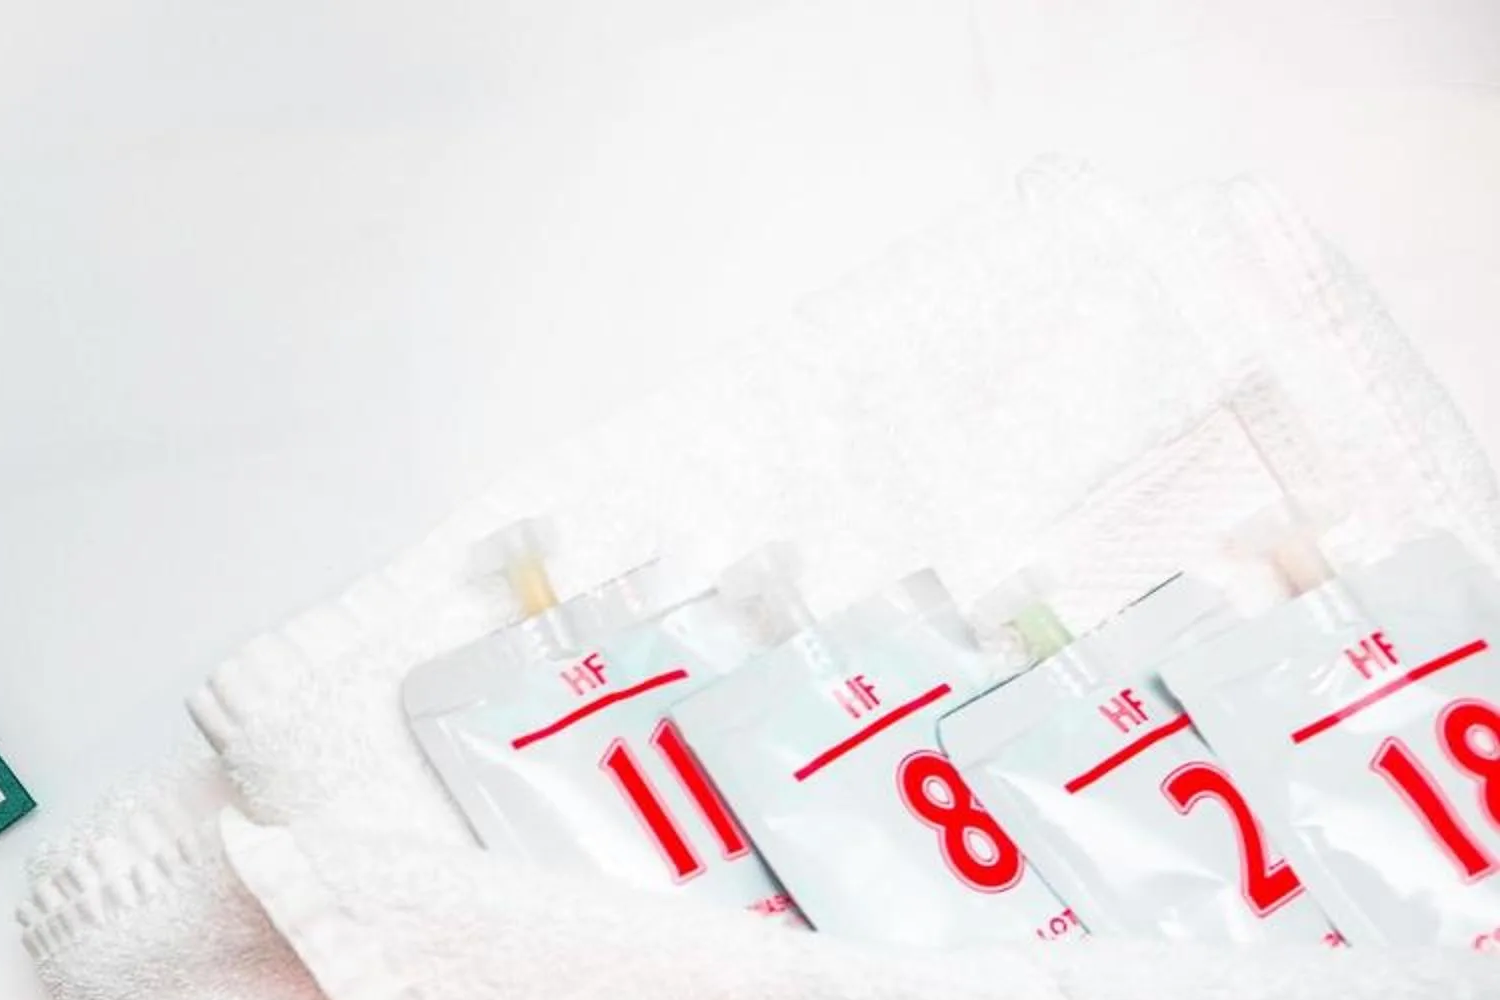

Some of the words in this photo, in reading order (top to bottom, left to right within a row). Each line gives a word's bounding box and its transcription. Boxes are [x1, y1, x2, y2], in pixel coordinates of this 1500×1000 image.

[560, 651, 609, 697] HF
[1345, 630, 1399, 681] HF
[834, 673, 882, 720] HF
[1099, 687, 1149, 734] HF
[602, 719, 750, 880] 11
[896, 750, 1025, 894] 8
[1161, 762, 1306, 917] 2
